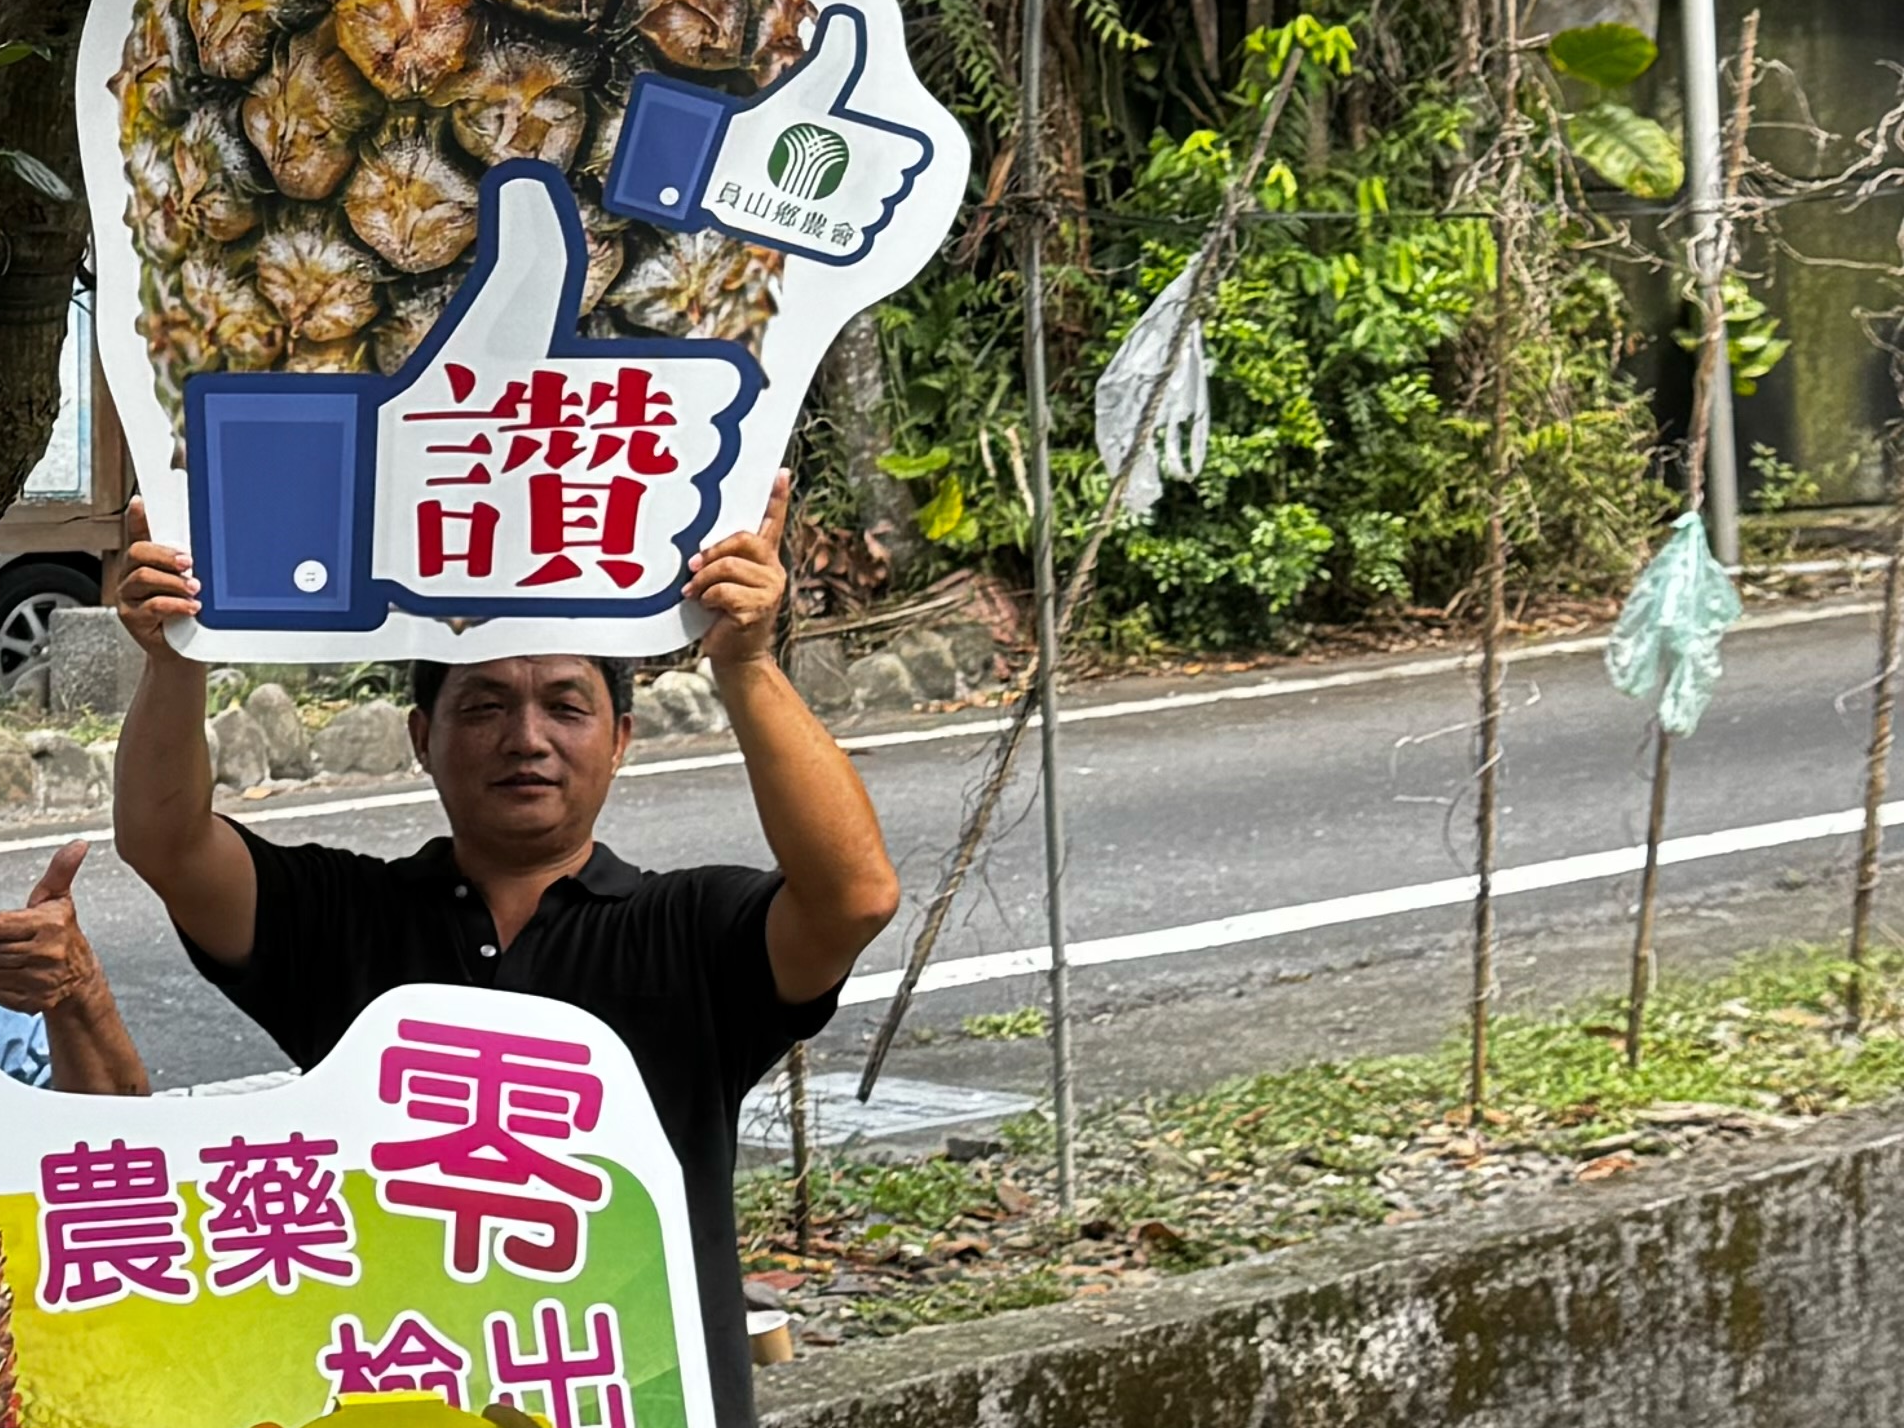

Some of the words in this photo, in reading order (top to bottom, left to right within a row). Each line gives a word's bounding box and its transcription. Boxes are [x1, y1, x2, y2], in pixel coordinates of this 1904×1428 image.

[715, 181, 856, 247] 員山鄉農會
[403, 363, 678, 588] 讚
